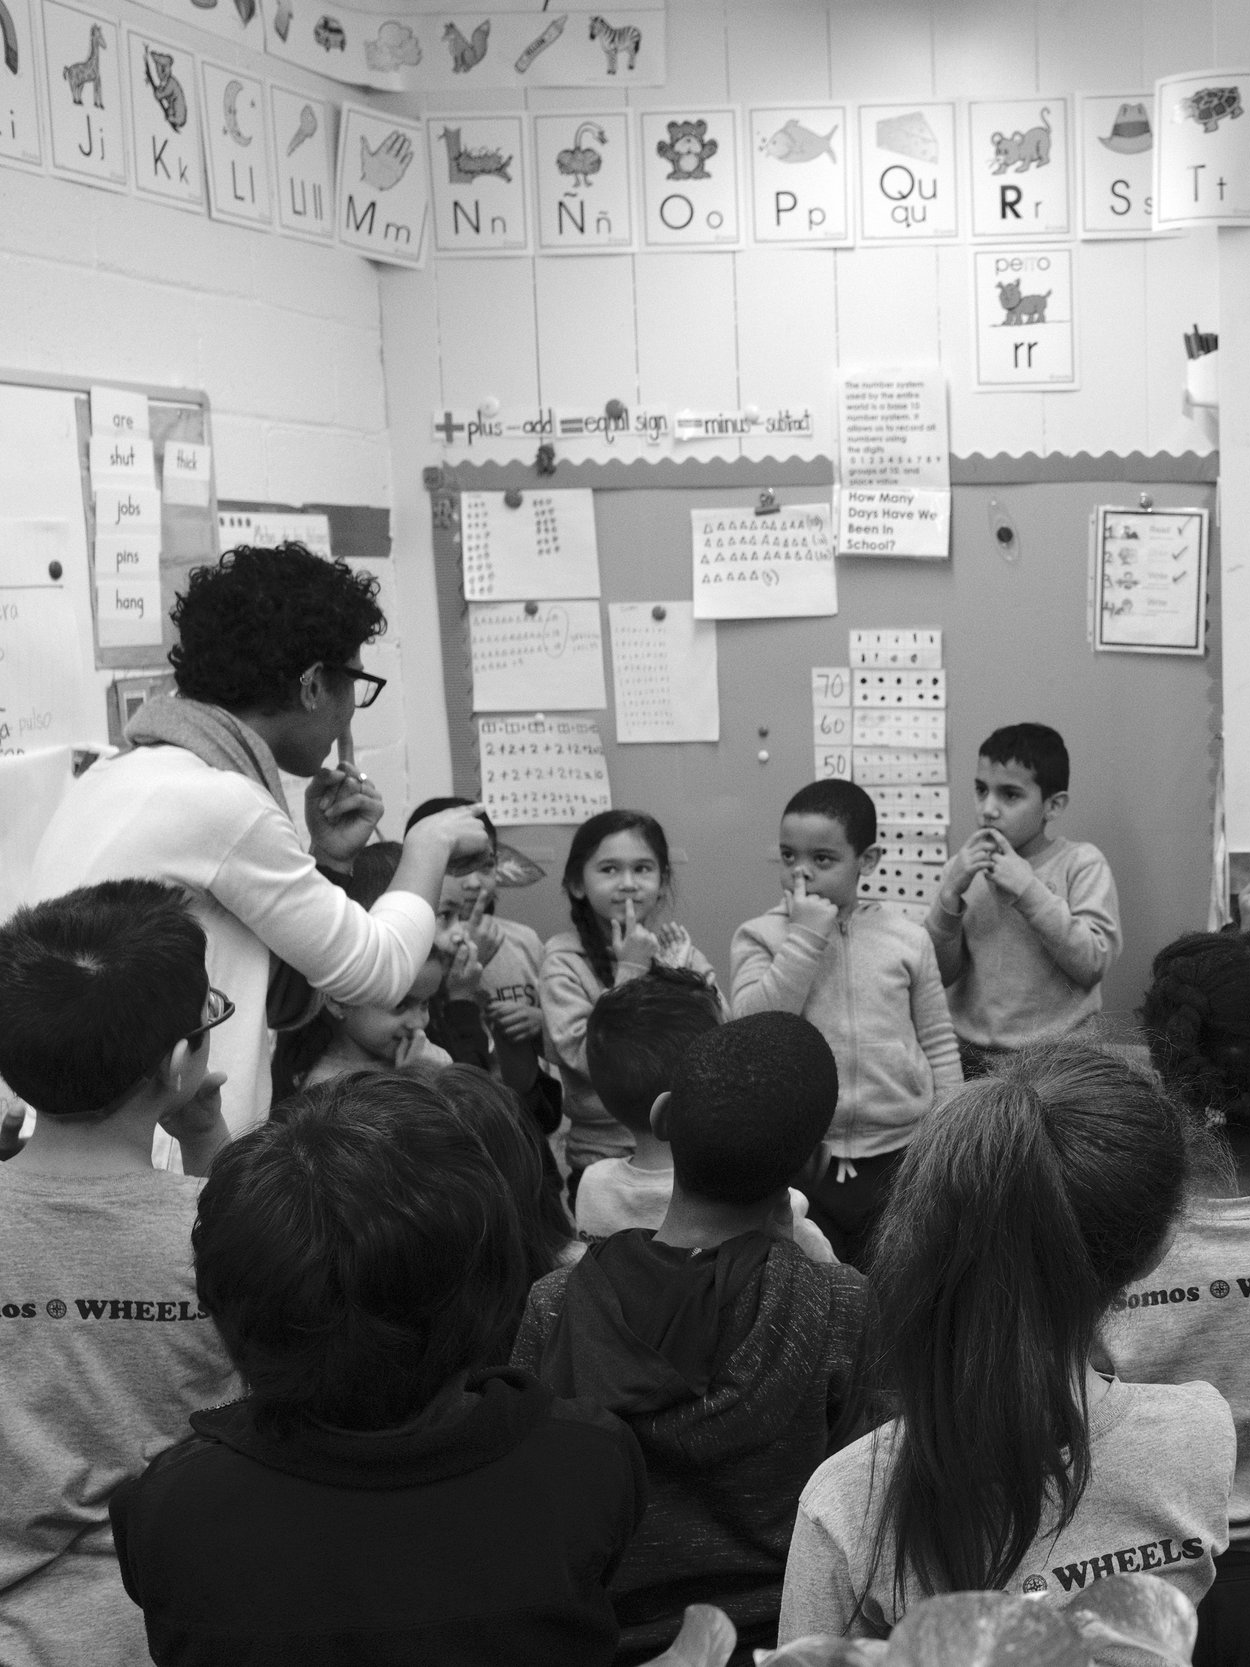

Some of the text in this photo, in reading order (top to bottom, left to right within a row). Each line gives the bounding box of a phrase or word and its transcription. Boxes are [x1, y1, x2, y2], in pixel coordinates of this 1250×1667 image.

[879, 164, 938, 201] Qu
[891, 204, 927, 228] qu
[1013, 340, 1039, 369] rr
[112, 413, 134, 430] are
[467, 409, 503, 445] plus
[522, 407, 554, 434] add
[634, 412, 668, 441] sign
[110, 447, 136, 467] shut
[176, 450, 198, 471] thick
[115, 494, 141, 525] jobs
[849, 492, 914, 506] How Many
[848, 507, 938, 521] Days Have We
[848, 523, 879, 535] Been
[847, 539, 896, 551] School?
[116, 549, 140, 573] pins
[115, 588, 144, 619] hang
[816, 673, 844, 699] 70
[820, 715, 845, 735] 60
[823, 754, 847, 778] 50
[1051, 1536, 1205, 1593] WHEELS
